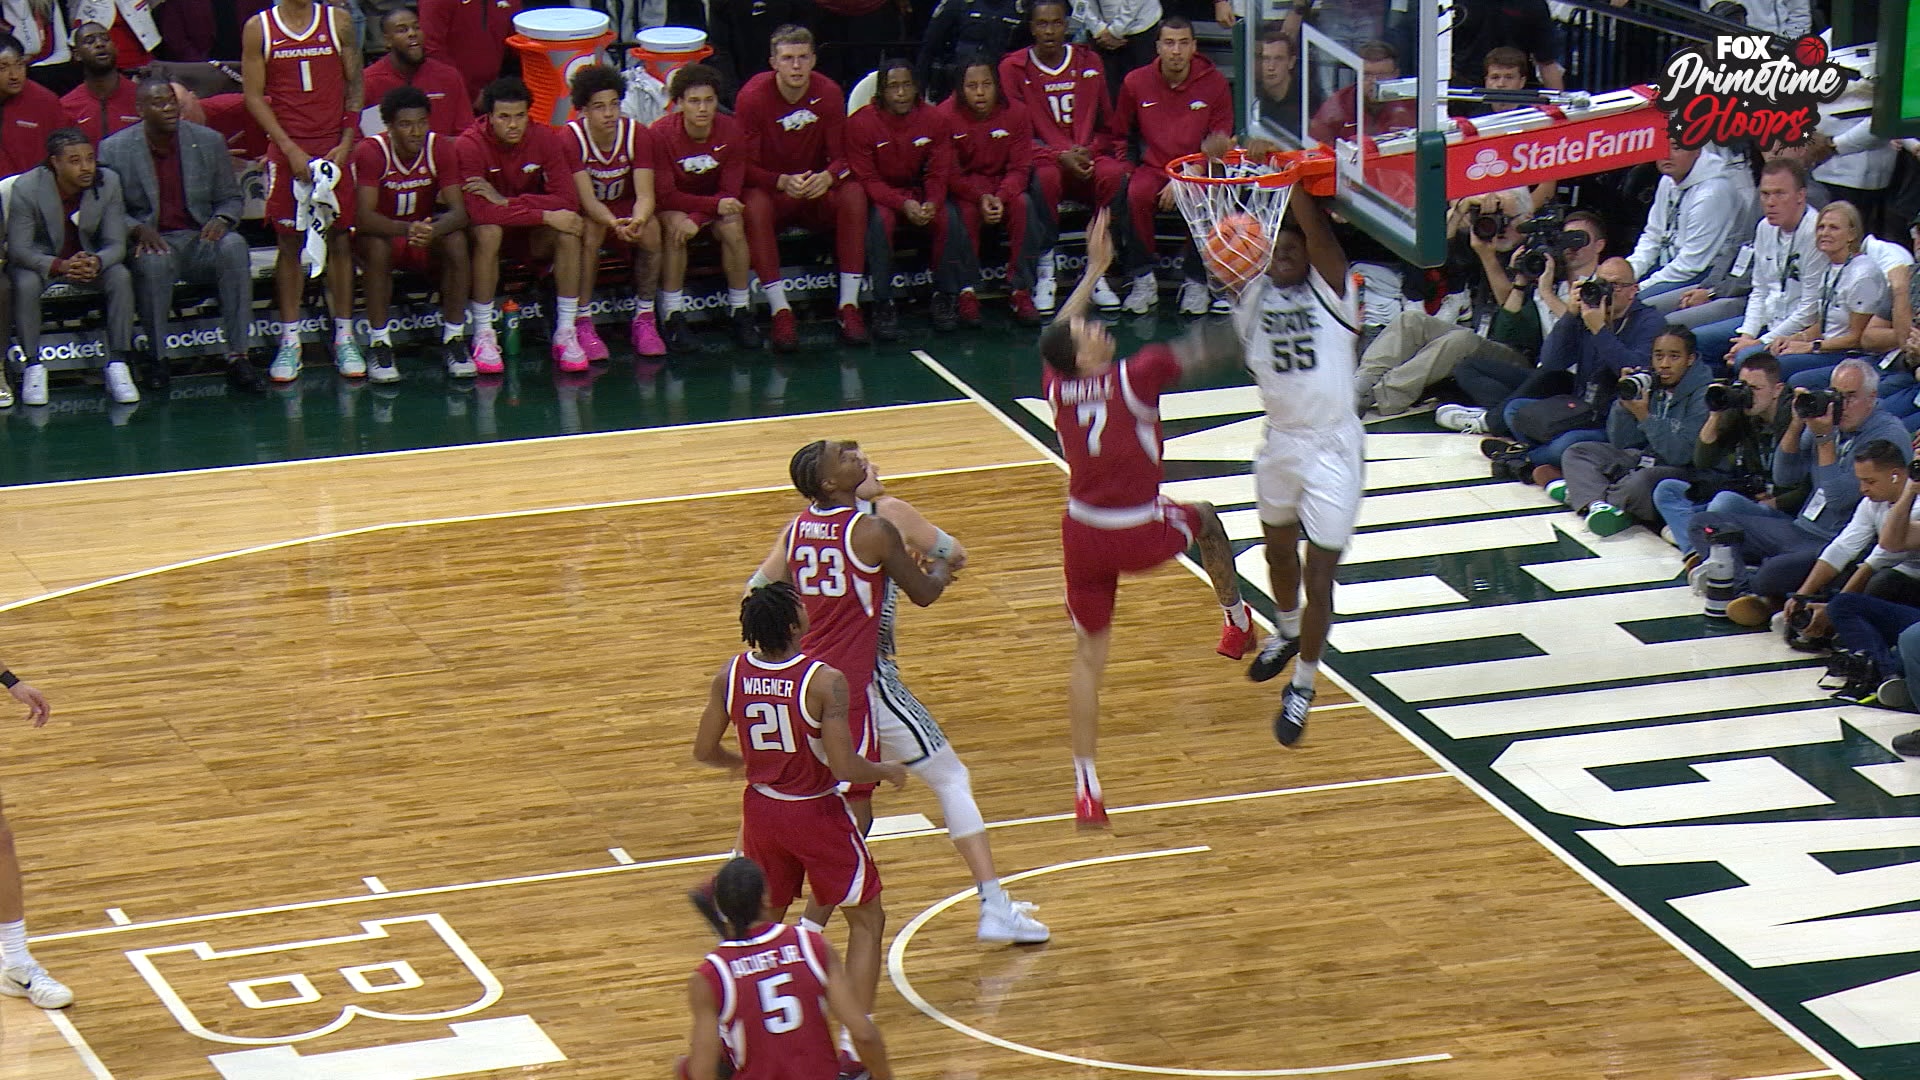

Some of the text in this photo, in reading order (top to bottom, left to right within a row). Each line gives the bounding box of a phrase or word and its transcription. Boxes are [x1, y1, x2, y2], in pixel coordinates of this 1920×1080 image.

[273, 46, 333, 59] ARKANSAS
[300, 60, 313, 92] 1
[396, 191, 418, 217] 11
[782, 271, 837, 291] ocket
[682, 291, 730, 312] Rock
[388, 311, 444, 332] ocket
[1262, 304, 1322, 333] STATE
[165, 327, 227, 349] ocket
[39, 340, 104, 361] ocket
[1271, 335, 1317, 374] 55
[1077, 401, 1108, 458] 7
[799, 521, 841, 541] PRINGLE
[795, 545, 848, 598] 23
[743, 677, 794, 698] WAGNER
[745, 702, 797, 753] 21
[757, 972, 804, 1034] 5
